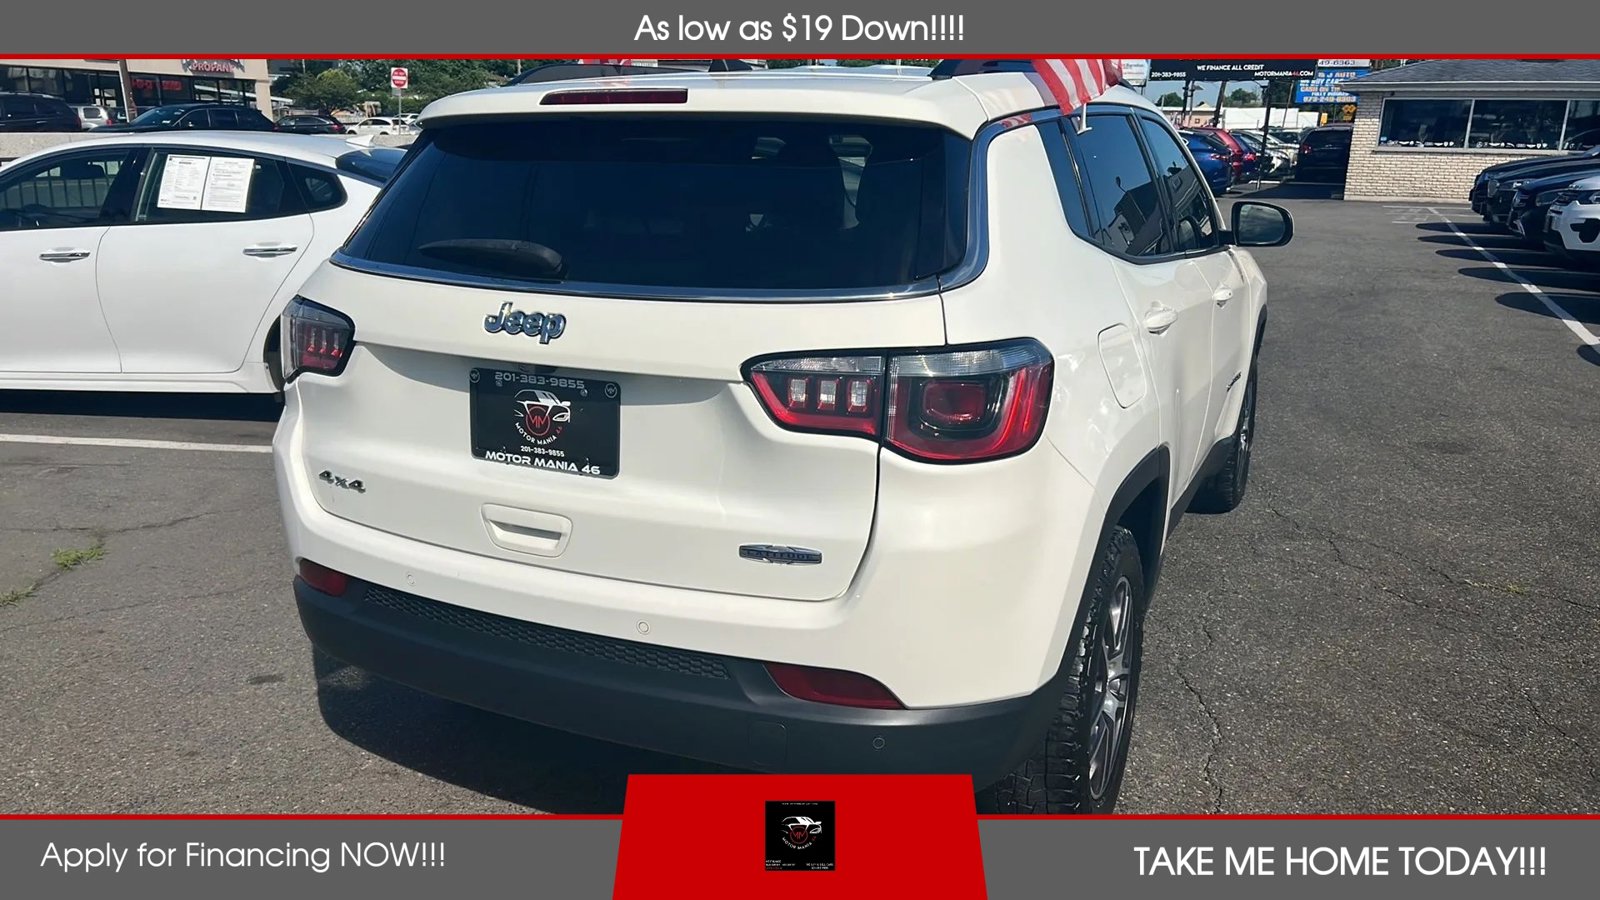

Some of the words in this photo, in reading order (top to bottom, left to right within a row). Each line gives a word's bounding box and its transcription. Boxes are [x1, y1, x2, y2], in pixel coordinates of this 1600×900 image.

[483, 301, 568, 345] Jeep
[494, 371, 586, 390] 201-383-9855
[514, 422, 536, 444] MOTOR
[537, 434, 558, 446] MANIA
[485, 450, 532, 466] MOTOR
[533, 457, 579, 472] MANIA
[581, 464, 601, 475] 46
[520, 445, 565, 458] 201-383-9855
[318, 470, 367, 494] 4x4
